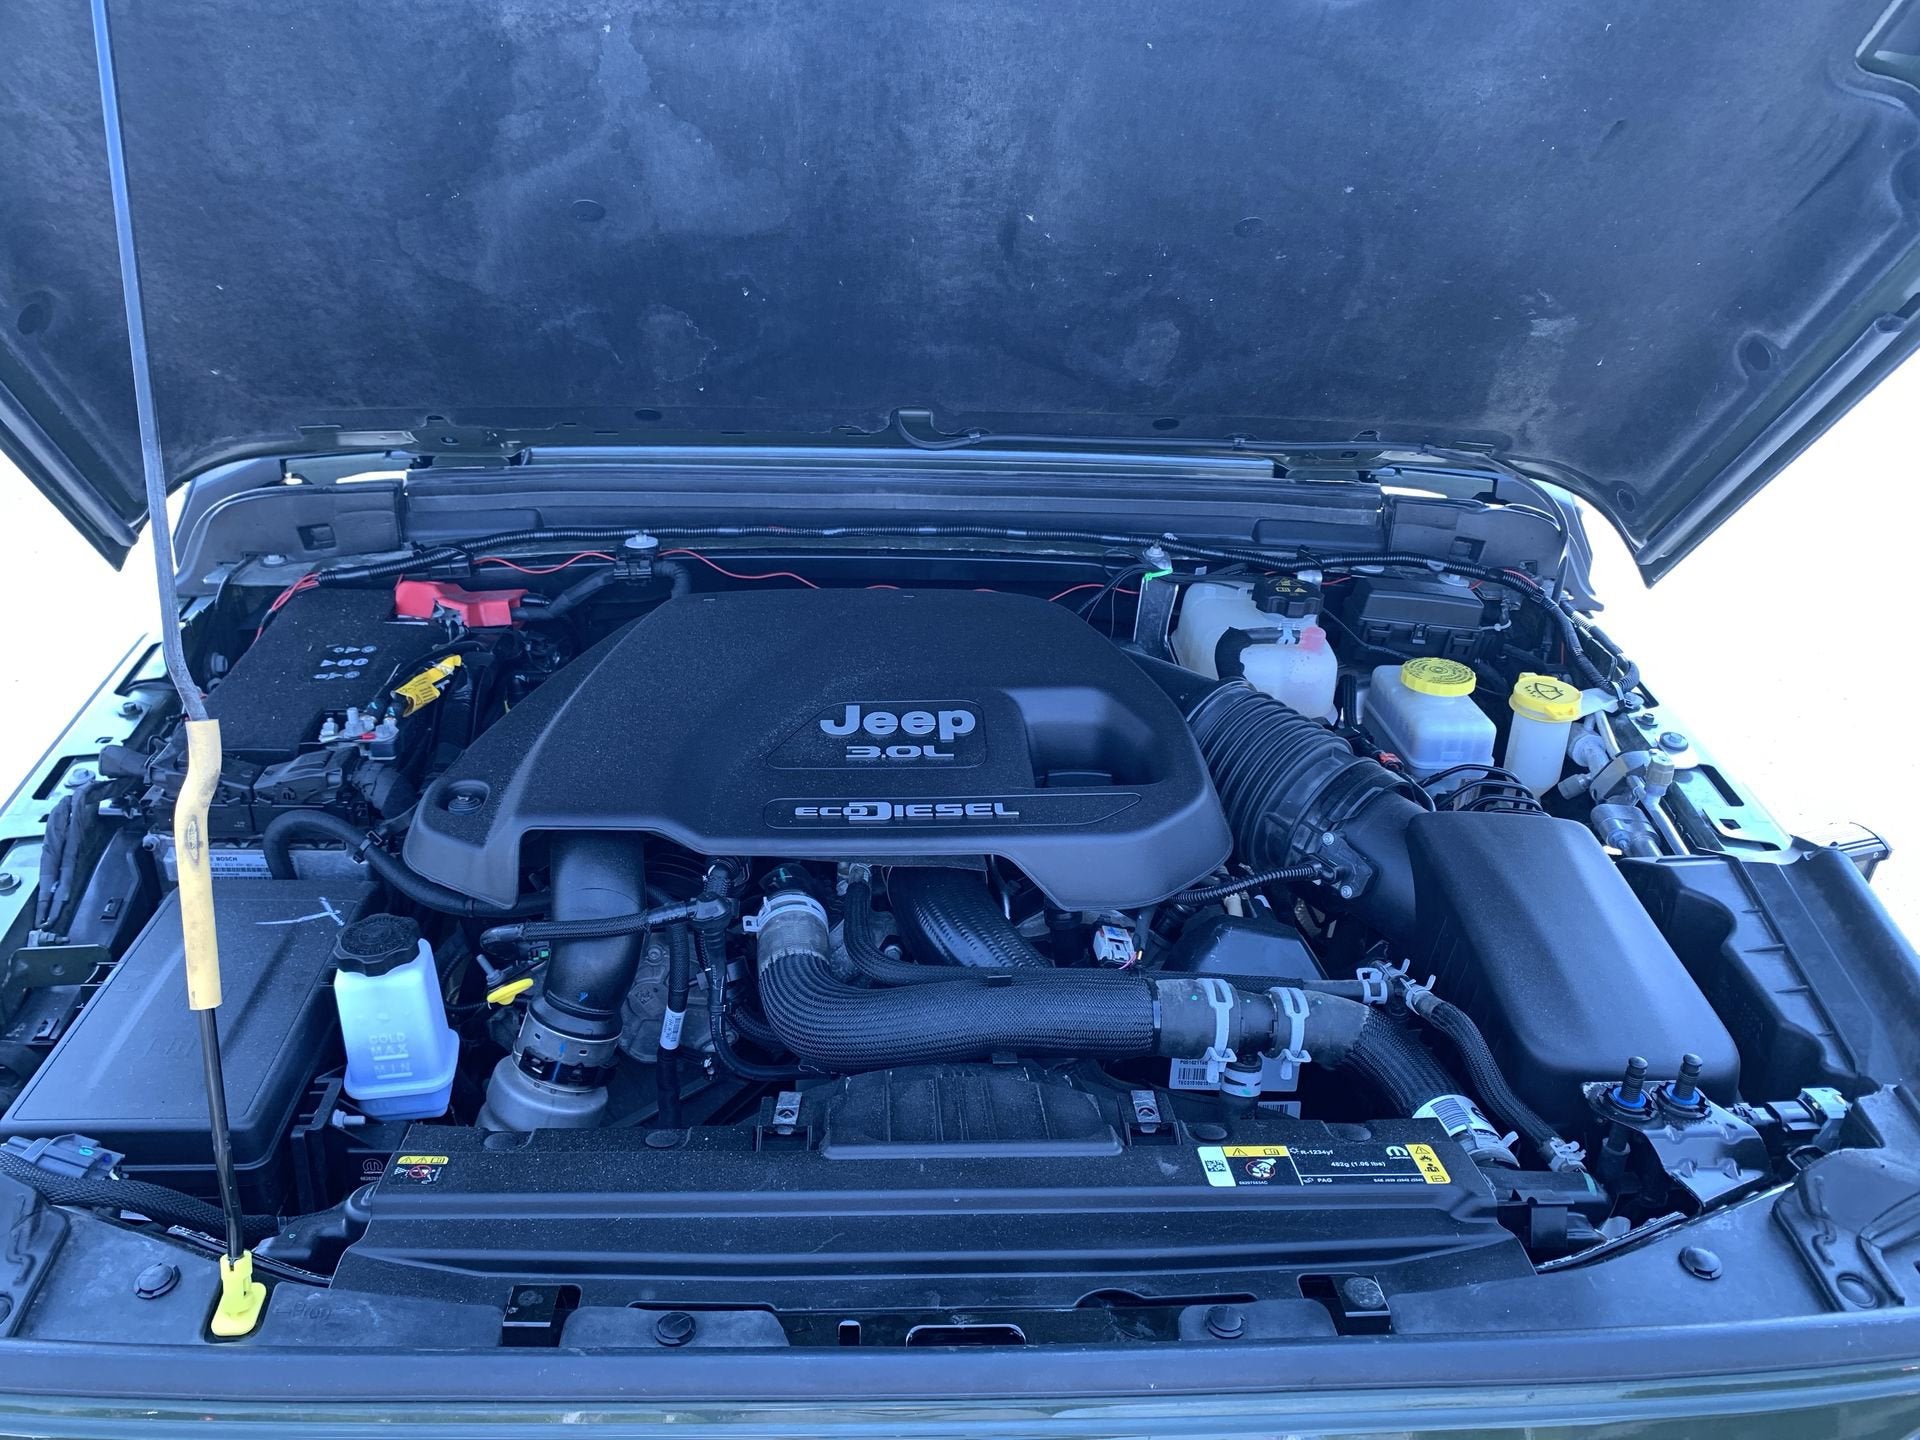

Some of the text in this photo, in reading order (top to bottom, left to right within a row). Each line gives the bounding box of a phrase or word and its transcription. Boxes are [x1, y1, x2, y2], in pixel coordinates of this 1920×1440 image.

[818, 704, 977, 743] Jeep
[845, 745, 955, 761] 3.0L
[369, 1032, 406, 1045] COLD
[370, 1044, 409, 1057] MAX
[373, 1062, 411, 1075] MIN
